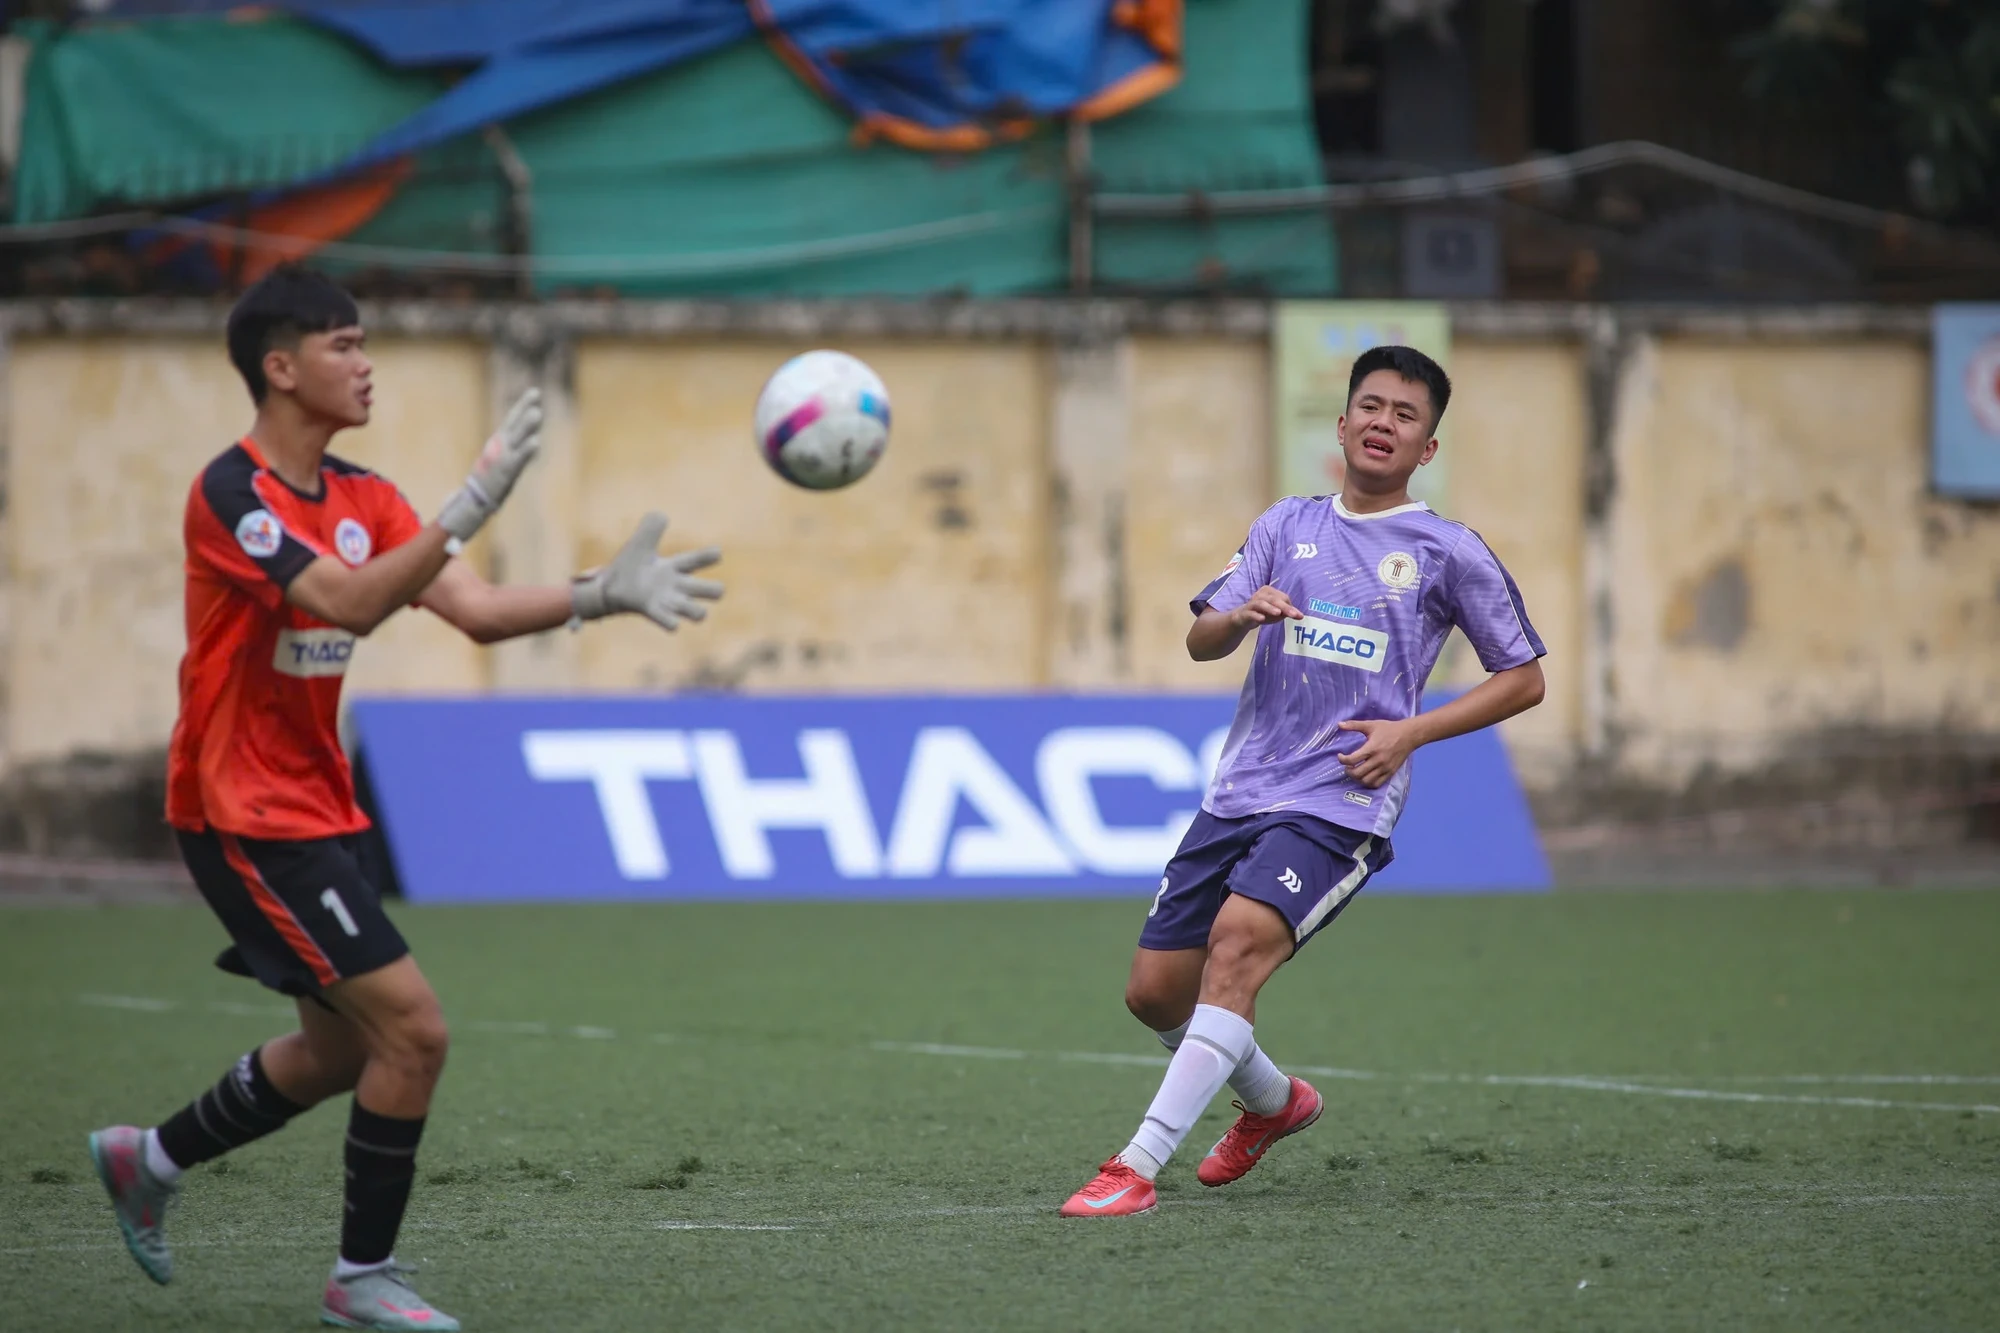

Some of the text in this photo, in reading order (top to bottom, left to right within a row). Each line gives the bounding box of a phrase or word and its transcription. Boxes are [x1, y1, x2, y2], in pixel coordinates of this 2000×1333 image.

[1309, 598, 1340, 616] THANH
[1294, 625, 1376, 659] THACO
[522, 726, 1231, 880] THAC
[320, 887, 360, 937] 1
